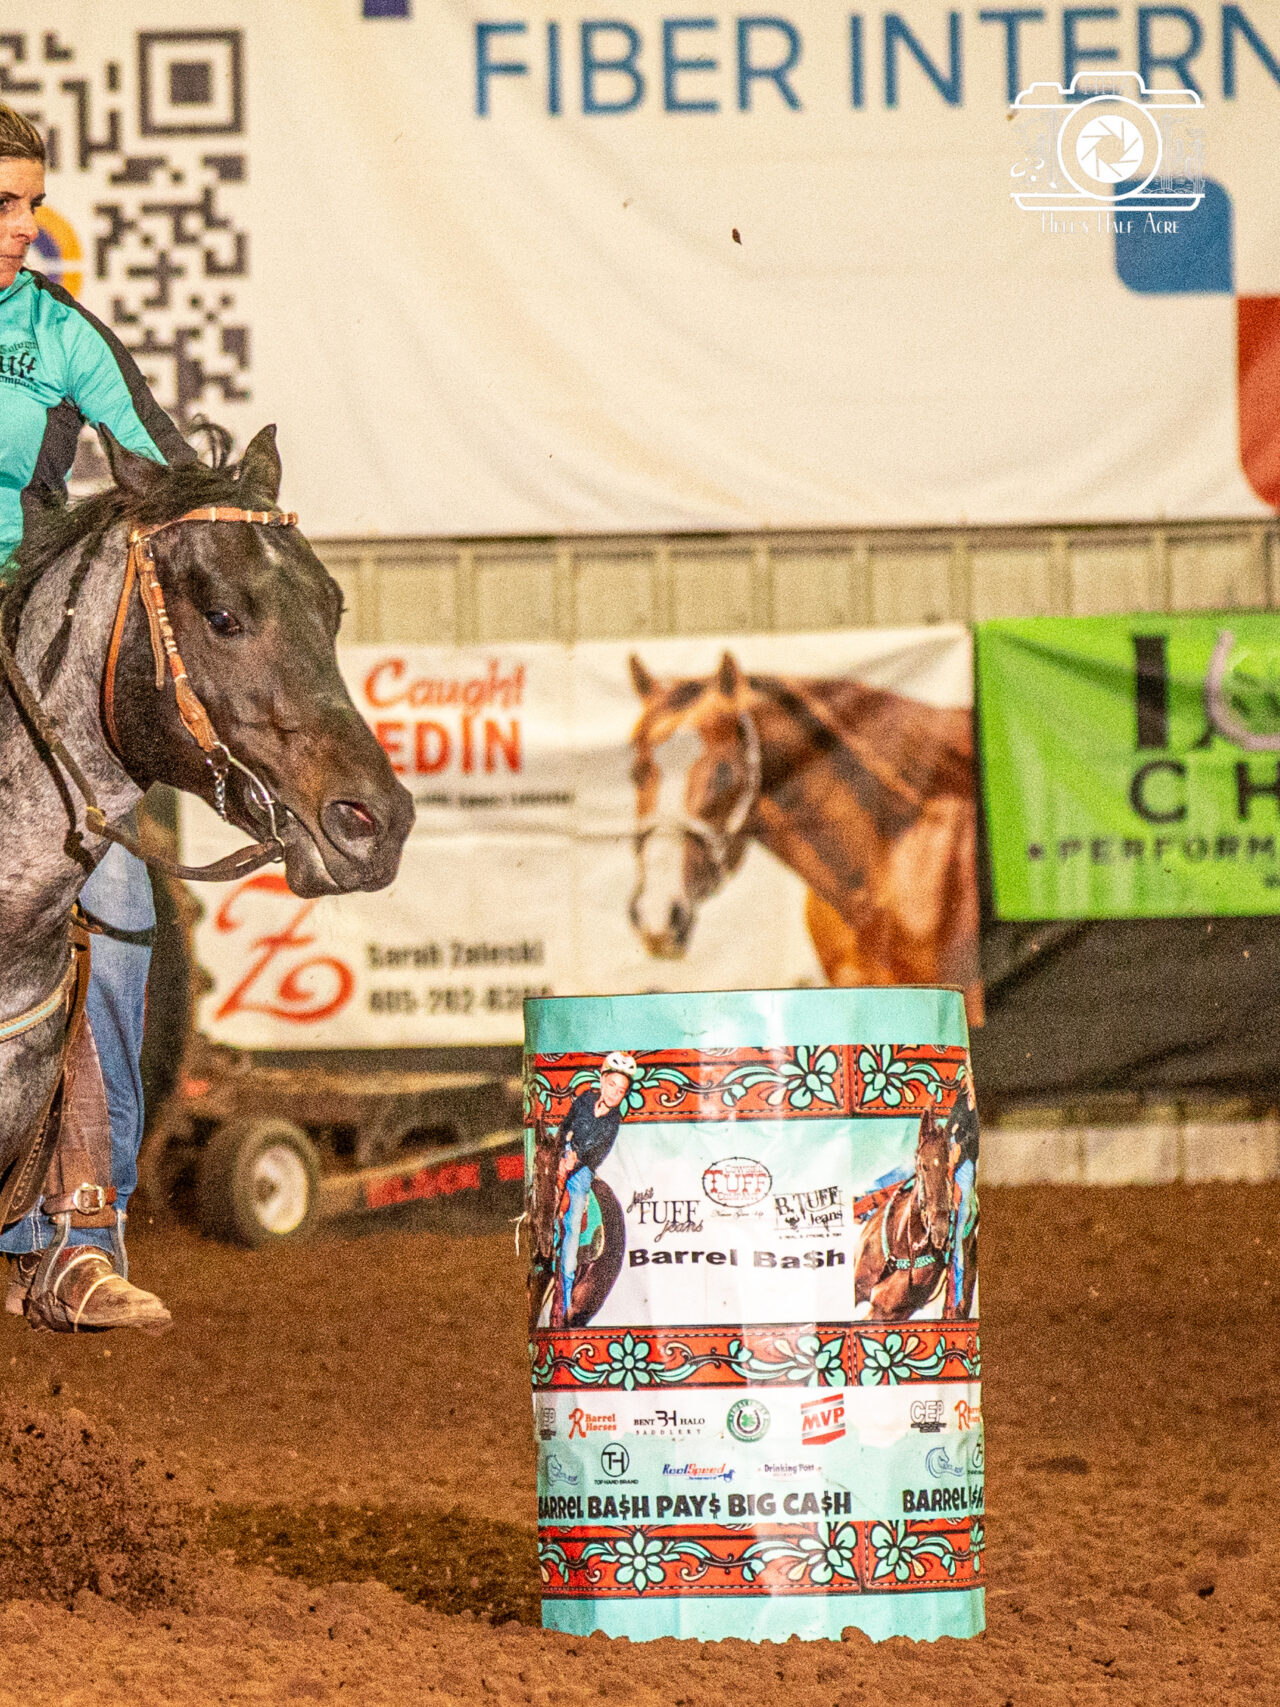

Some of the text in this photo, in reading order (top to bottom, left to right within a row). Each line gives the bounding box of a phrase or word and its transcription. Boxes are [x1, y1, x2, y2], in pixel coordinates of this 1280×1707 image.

[476, 4, 1280, 118] FIBER INTERN
[364, 658, 526, 722] Caught
[703, 1169, 767, 1193] TUFF
[634, 1199, 701, 1224] TUFF
[793, 1186, 839, 1220] TUFF
[628, 1248, 845, 1270] Barrel Ba$h
[586, 1414, 616, 1422] Barrel
[802, 1407, 845, 1432] MVP
[910, 1400, 944, 1423] CEP
[586, 1423, 617, 1431] Horses
[764, 1464, 797, 1474] Drinking
[587, 1494, 650, 1521] BA$H
[656, 1493, 721, 1519] PAY$
[728, 1493, 776, 1517] BIG
[783, 1491, 852, 1517] CA$H
